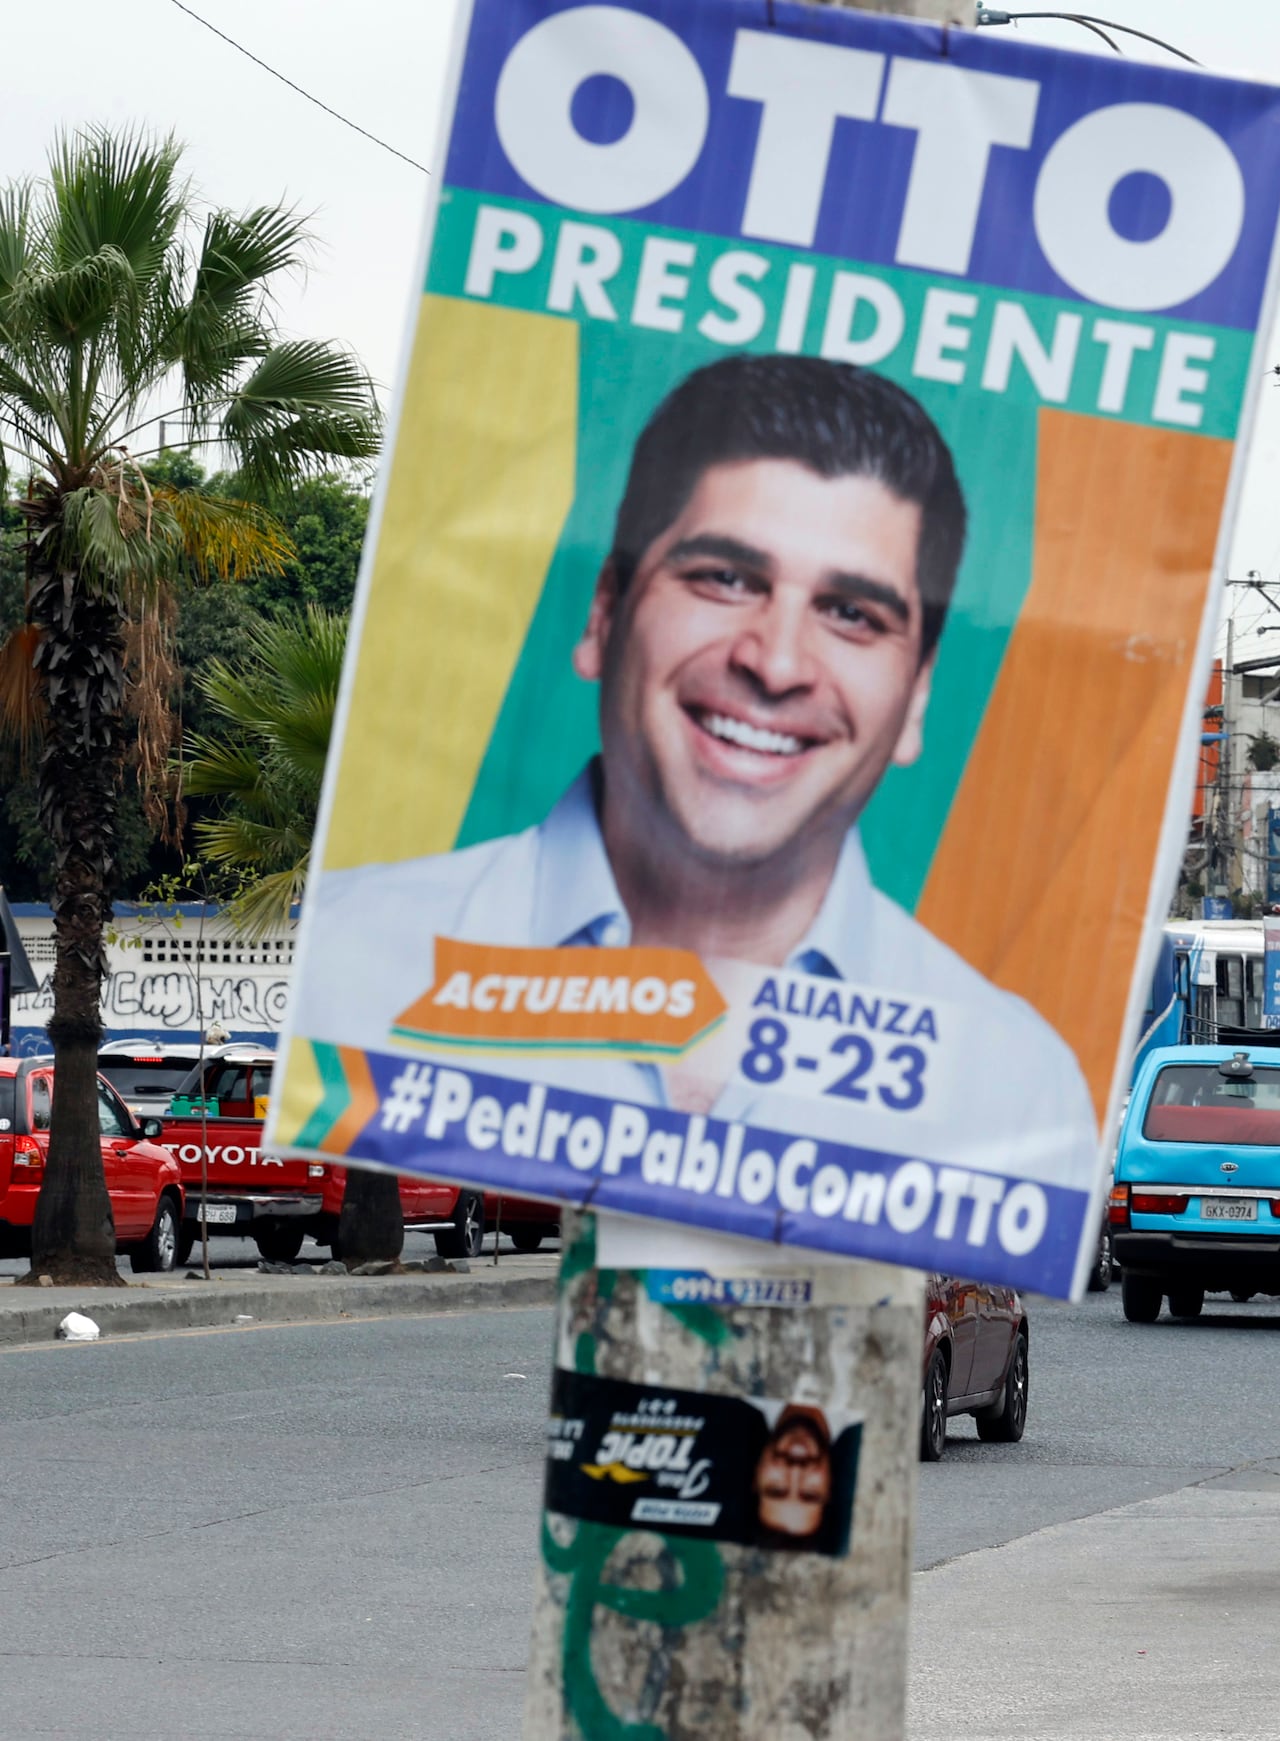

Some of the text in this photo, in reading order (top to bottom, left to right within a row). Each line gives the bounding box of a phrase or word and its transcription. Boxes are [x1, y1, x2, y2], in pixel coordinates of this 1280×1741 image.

[494, 4, 1246, 313] OTTO
[462, 203, 1215, 428] PRESIDENTE
[433, 970, 697, 1018] ACTUEMOS
[750, 977, 939, 1042] ALIANZA
[739, 1018, 930, 1111] 8-23
[162, 1143, 285, 1168] TOYOTA
[381, 1062, 1048, 1257] #PedroPabloConOTTO
[594, 1431, 696, 1470] TOPIC
